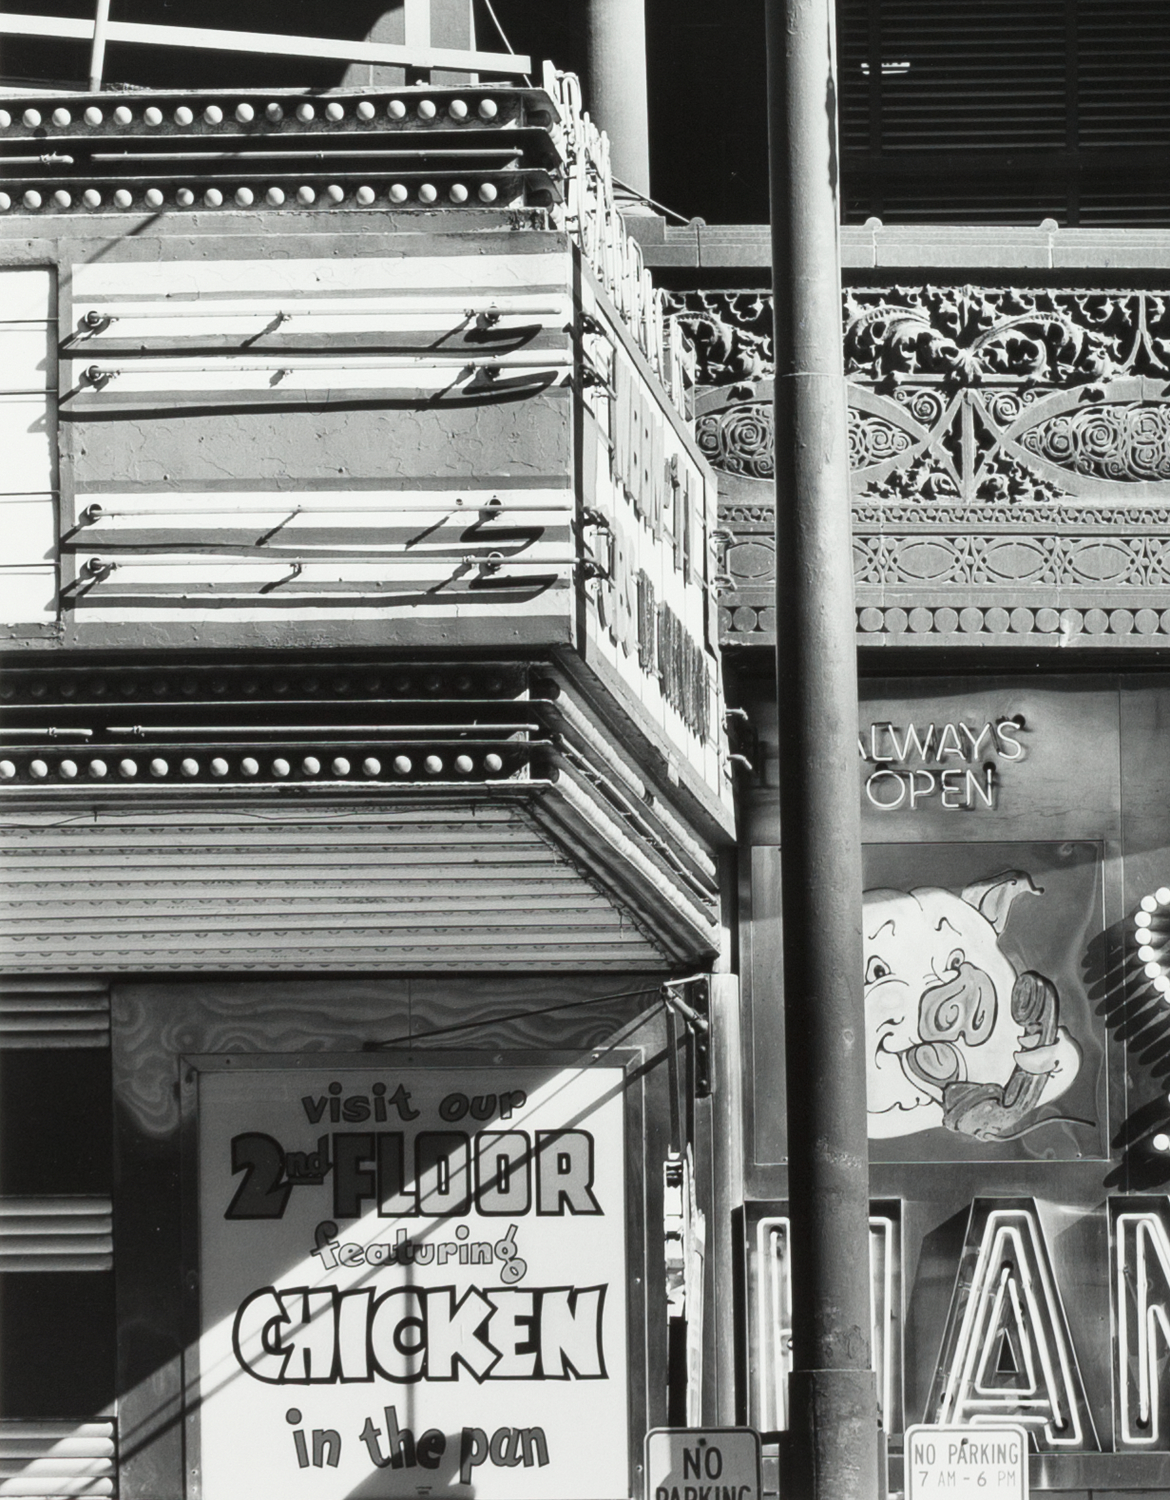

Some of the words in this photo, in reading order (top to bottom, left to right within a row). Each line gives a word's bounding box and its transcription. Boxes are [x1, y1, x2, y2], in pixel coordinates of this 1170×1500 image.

[858, 721, 1022, 762] LWAYS
[866, 769, 993, 808] OPEN
[301, 1082, 420, 1124] visit
[439, 1088, 527, 1121] our
[224, 1132, 334, 1220] 2nd
[332, 1129, 605, 1219] FLOOR
[311, 1220, 527, 1284] featuring
[232, 1283, 609, 1386] CHICKEN
[285, 1407, 342, 1469] in
[359, 1405, 447, 1470] the
[459, 1426, 550, 1485] pan
[683, 1447, 722, 1480] NO
[914, 1443, 936, 1466] NO
[948, 1442, 1019, 1465] PARKING
[919, 1470, 929, 1487] 7
[938, 1470, 956, 1487] AM
[977, 1470, 987, 1487] 6
[998, 1470, 1016, 1487] PM
